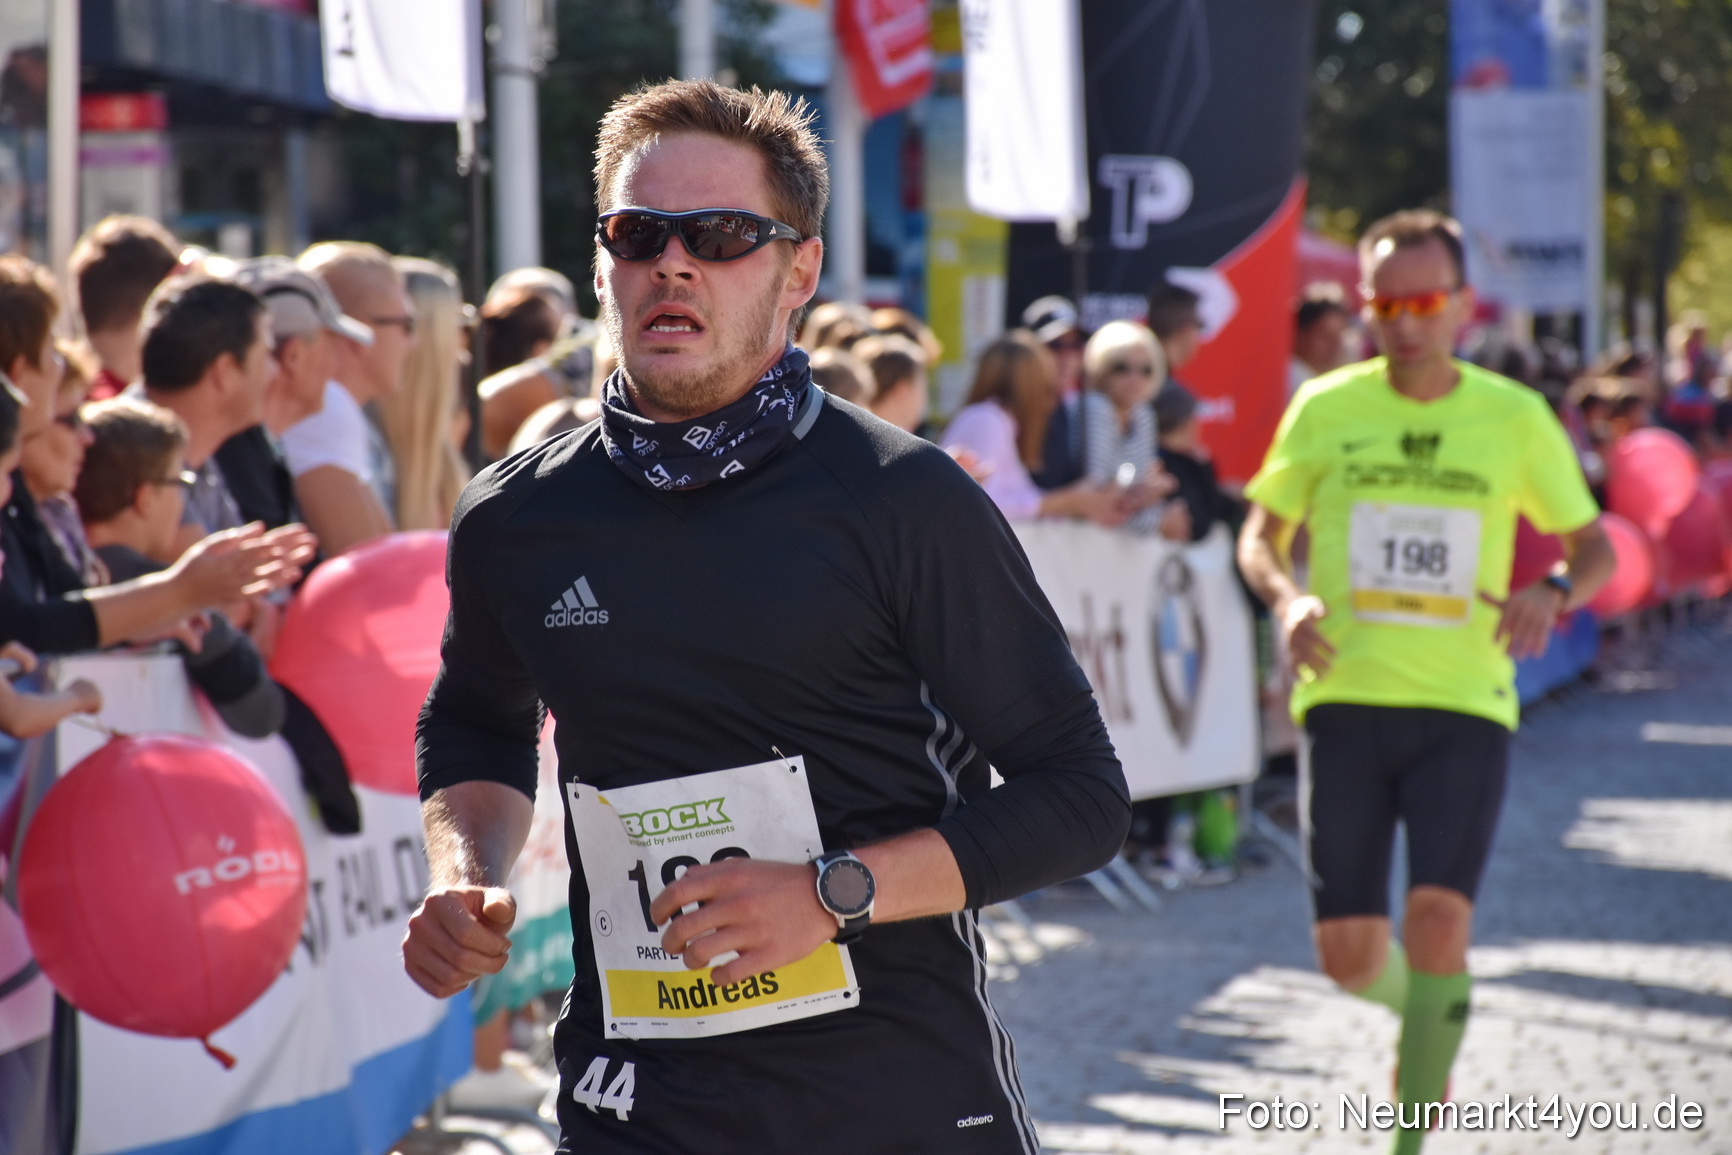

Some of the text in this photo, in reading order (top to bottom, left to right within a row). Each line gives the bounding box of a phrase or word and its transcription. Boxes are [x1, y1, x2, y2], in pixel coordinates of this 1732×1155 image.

[1382, 537, 1448, 577] 198
[544, 606, 609, 628] adidas
[618, 797, 732, 838] BOCK
[654, 837, 665, 847] by
[667, 831, 693, 844] smart
[695, 824, 736, 839] concepts
[657, 970, 780, 1011] Andreas
[573, 1056, 636, 1121] 44
[957, 1114, 994, 1128] adizero
